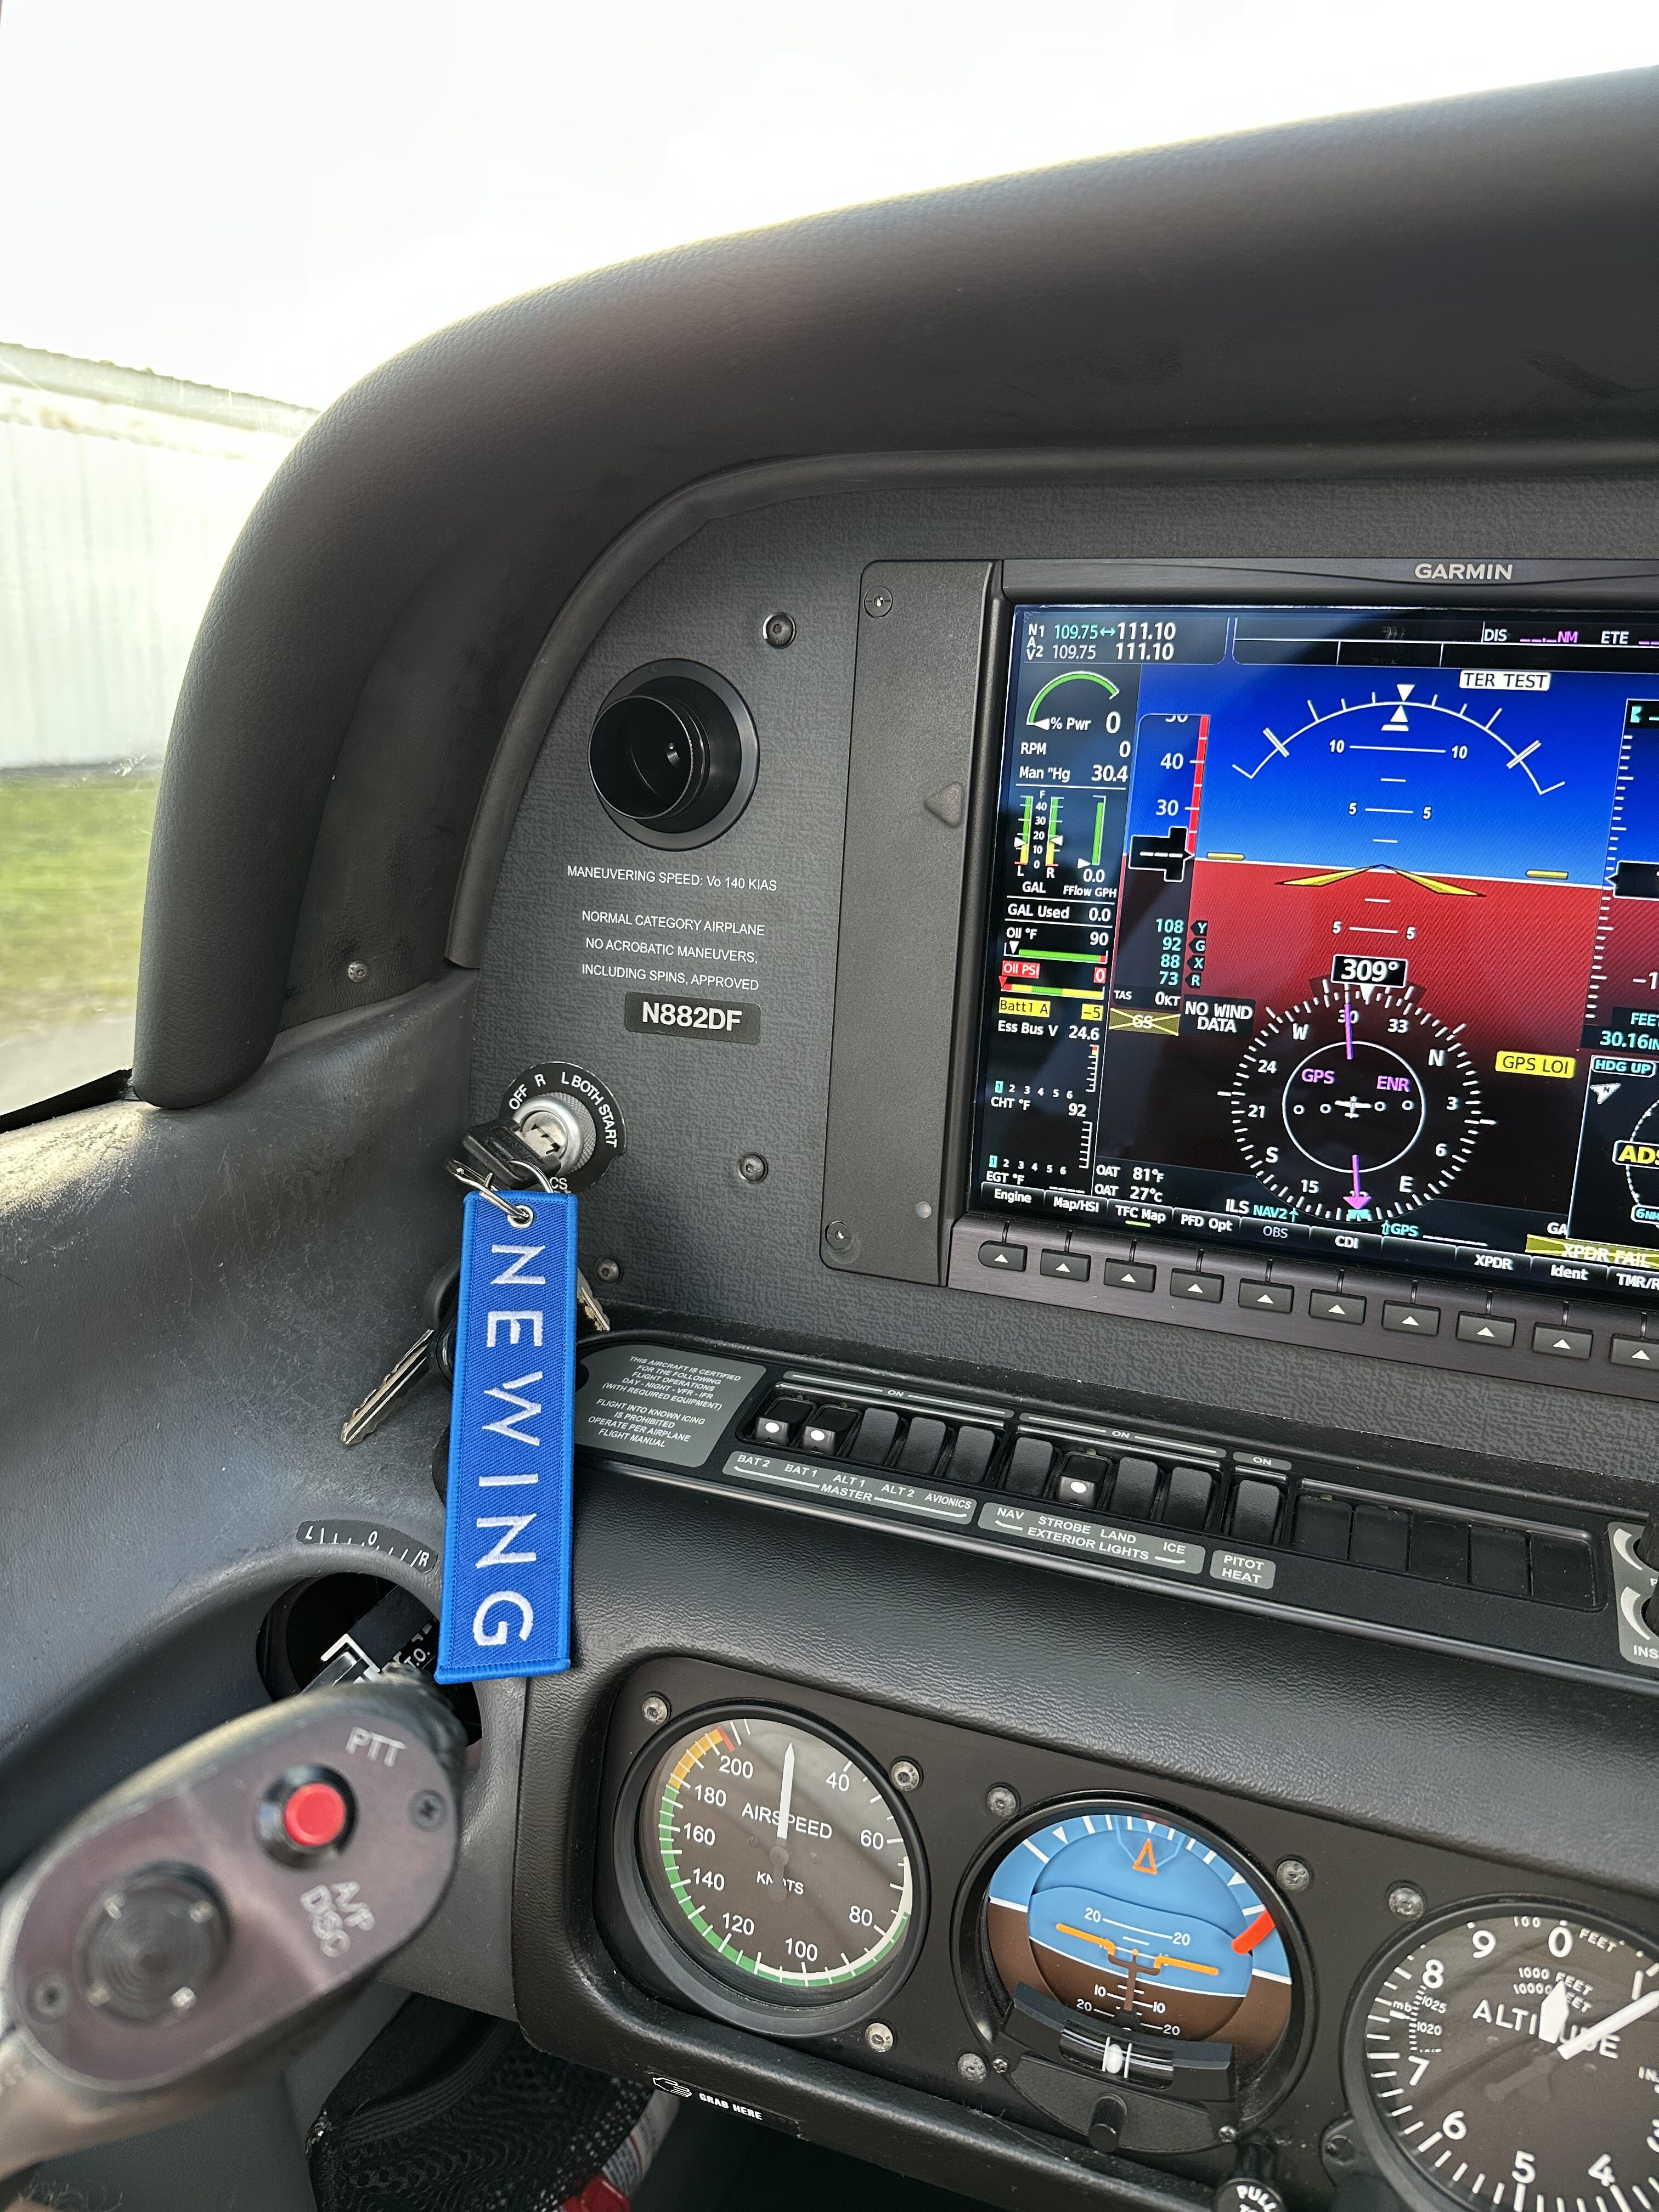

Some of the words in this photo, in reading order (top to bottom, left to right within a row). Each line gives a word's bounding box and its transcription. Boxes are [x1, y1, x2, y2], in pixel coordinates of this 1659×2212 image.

[1415, 563, 1513, 579] GARMIN
[1054, 624, 1098, 640] 109.75
[1118, 622, 1176, 640] 111.10
[1485, 629, 1507, 641] DIS
[1601, 631, 1628, 644] ETE
[1052, 645, 1096, 660] 109.75
[1116, 642, 1173, 661] 111.10
[1464, 673, 1495, 686] TER
[1504, 674, 1548, 688] TEST
[1065, 718, 1091, 731] Pwr
[1106, 713, 1120, 733] 0
[1020, 742, 1046, 755] RPM
[1329, 740, 1345, 753] 10
[1452, 746, 1468, 759] 10
[1161, 753, 1184, 770] 40
[1019, 768, 1044, 779] Man
[1091, 765, 1128, 782] 30.4
[1156, 800, 1179, 816] 30
[567, 865, 655, 882] MANEUVERING
[659, 872, 703, 887] SPEED:
[725, 877, 745, 889] 140
[749, 879, 777, 891] KIAS
[1083, 868, 1105, 883] 0.0
[1023, 882, 1046, 893] GAL
[1007, 904, 1033, 917] GAL
[1038, 906, 1070, 919] Used
[1089, 907, 1111, 922] 0.0
[582, 910, 632, 925] NORMAL
[635, 915, 702, 931] CATEGORY
[703, 920, 765, 936] AIRPLANE
[1156, 918, 1183, 933] 108
[1006, 928, 1022, 938] Oil
[1090, 932, 1109, 946] 90
[1163, 936, 1181, 951] 92
[586, 938, 603, 949] NO
[606, 939, 674, 956] ACROBATIC
[678, 946, 758, 964] MANEUVERS,
[1003, 963, 1020, 974] Oil
[1022, 965, 1040, 976] PSI
[1160, 955, 1180, 968] 88
[1341, 959, 1398, 981] 309°
[582, 964, 646, 980] INCLUDING
[650, 970, 688, 985] SPINS,
[691, 974, 759, 990] APPROVED
[1159, 971, 1178, 985] 73
[1114, 990, 1132, 1000] TAS
[642, 1001, 742, 1031] N882DF
[1000, 1000, 1034, 1011] Batt1
[1040, 1003, 1048, 1014] A
[1186, 1001, 1208, 1015] NO
[1214, 1003, 1251, 1019] WIND
[998, 1020, 1017, 1032] Ess
[1022, 1023, 1043, 1035] Bus
[1048, 1024, 1058, 1036] V
[1068, 1025, 1099, 1040] 24.6
[1197, 1017, 1237, 1032] DATA
[1503, 1056, 1536, 1071] GPS
[1543, 1060, 1568, 1075] LOI
[1595, 1062, 1627, 1073] HDG
[1632, 1062, 1651, 1074] UP
[1302, 1068, 1335, 1084] GPS
[1377, 1076, 1410, 1092] ENR
[509, 1084, 527, 1110] OFF
[571, 1075, 604, 1105] BOTH
[599, 1104, 617, 1148] START
[991, 1097, 1015, 1108] CHT
[1068, 1103, 1086, 1118] 92
[986, 1171, 1009, 1182] EGT
[1096, 1165, 1120, 1177] OAT
[994, 1189, 1031, 1204] Engine
[1053, 1197, 1099, 1213] Map/HSI
[1116, 1205, 1138, 1218] TFC
[1142, 1208, 1166, 1223] Map
[1226, 1199, 1249, 1214] ILS
[1181, 1214, 1204, 1227] PFD
[1208, 1218, 1233, 1233] Opt
[1263, 1226, 1289, 1238] OBS
[1335, 1235, 1359, 1249] CDI
[1475, 1254, 1513, 1270] XPDR
[1551, 1265, 1589, 1280] Ident
[648, 1359, 689, 1372] AIRCRAFT
[699, 1368, 741, 1381] CERTIFIED
[672, 1370, 721, 1385] FOLLOWING
[622, 1378, 641, 1386] DAY
[646, 1381, 670, 1391] NIGHT
[676, 1387, 694, 1396] VFR
[632, 1372, 661, 1381] FLIGHT
[662, 1378, 715, 1391] OPERATIONS
[602, 1383, 627, 1393] (WITH
[628, 1386, 670, 1400] REQUIRED
[671, 1395, 723, 1411] EQUIPMENT)
[887, 1389, 904, 1397] ON
[597, 1399, 627, 1410] FLIGHT
[628, 1405, 648, 1414] INTO
[648, 1408, 684, 1420] KNOWN
[681, 1414, 706, 1425] ICING
[624, 1413, 675, 1428] PROHIBITED
[588, 1417, 629, 1429] OPERATE
[630, 1424, 647, 1433] PER
[646, 1426, 691, 1442] AIRPLANE
[599, 1429, 630, 1440] FLIGHT
[630, 1434, 665, 1448] MANUAL
[1111, 1430, 1130, 1439] ON
[473, 1244, 546, 1646] NEWING
[737, 1454, 759, 1466] BAT
[1252, 1456, 1272, 1466] ON
[785, 1464, 810, 1476] BAT
[832, 1474, 855, 1485] ALT
[820, 1483, 873, 1502] MASTER
[881, 1484, 904, 1496] ALT
[924, 1493, 972, 1510] AVIONICS
[997, 1508, 1025, 1520] NAV
[1038, 1516, 1092, 1534] STROBE
[1027, 1526, 1096, 1550] EXTERIOR
[1098, 1542, 1149, 1560] LIGHTS
[1100, 1528, 1137, 1544] LAND
[1163, 1542, 1186, 1555] ICE
[1224, 1555, 1264, 1571] PITOT
[1222, 1568, 1262, 1584] HEAT
[345, 1727, 407, 1767] PTT
[719, 1756, 754, 1778] 200
[826, 1772, 850, 1792] 40
[695, 1784, 726, 1807] 180
[742, 1803, 832, 1839] AIRSPEED
[684, 1823, 715, 1846] 160
[860, 1830, 884, 1850] 60
[692, 1869, 725, 1891] 140
[722, 1912, 755, 1936] 120
[849, 1906, 872, 1926] 80
[1085, 1908, 1101, 1923] 20
[1514, 1916, 1541, 1928] 100
[1172, 1932, 1190, 1946] 20
[1472, 1930, 1496, 1959] 9
[1548, 1926, 1573, 1957] 0
[1579, 1928, 1617, 1953] FEET
[785, 1938, 818, 1962] 100
[1423, 1959, 1444, 1989] 8
[1421, 1995, 1447, 2013] 1025
[1417, 2022, 1442, 2036] 1020
[1408, 2056, 1430, 2086] 7
[699, 2094, 729, 2109] GRAB
[733, 2104, 763, 2120] HERE
[1443, 2111, 1467, 2141] 6
[1512, 2151, 1536, 2183] 5
[1588, 2154, 1615, 2186] 4
[1237, 2185, 1277, 2212] PULL
